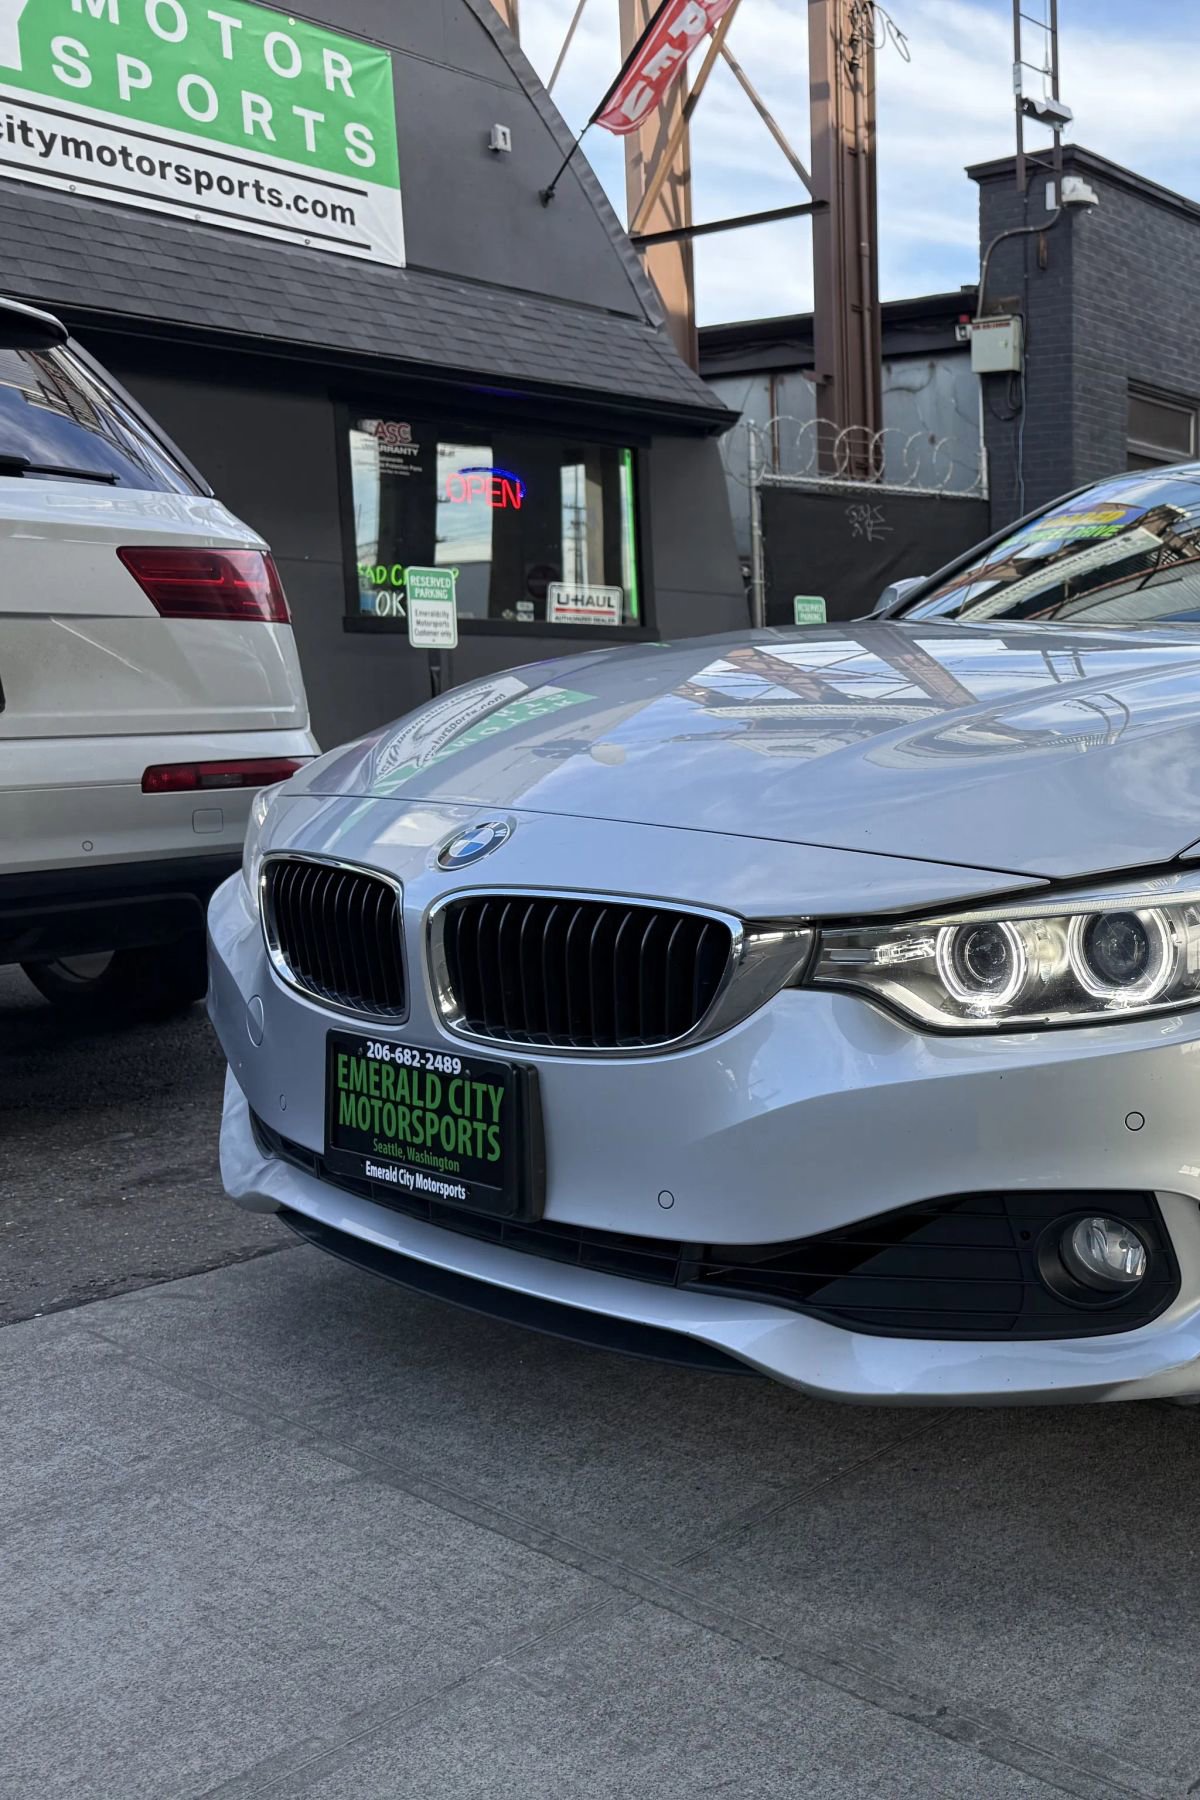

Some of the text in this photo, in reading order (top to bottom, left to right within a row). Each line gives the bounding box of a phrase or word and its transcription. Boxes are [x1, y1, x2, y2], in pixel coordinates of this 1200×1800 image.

[620, 0, 717, 122] PEN
[50, 35, 376, 168] SPORTS
[374, 421, 411, 444] ASC
[446, 472, 521, 509] OPEN
[410, 575, 451, 588] RESERVED
[415, 587, 448, 599] PARKING
[376, 591, 406, 616] OK
[366, 1041, 462, 1075] 206-682-2489
[337, 1053, 505, 1123] EMERALD CITY
[338, 1091, 501, 1162] MOTORSPORTS
[372, 1137, 461, 1173] Seattle, Washington
[365, 1160, 467, 1199] Emerald City Motorsports
